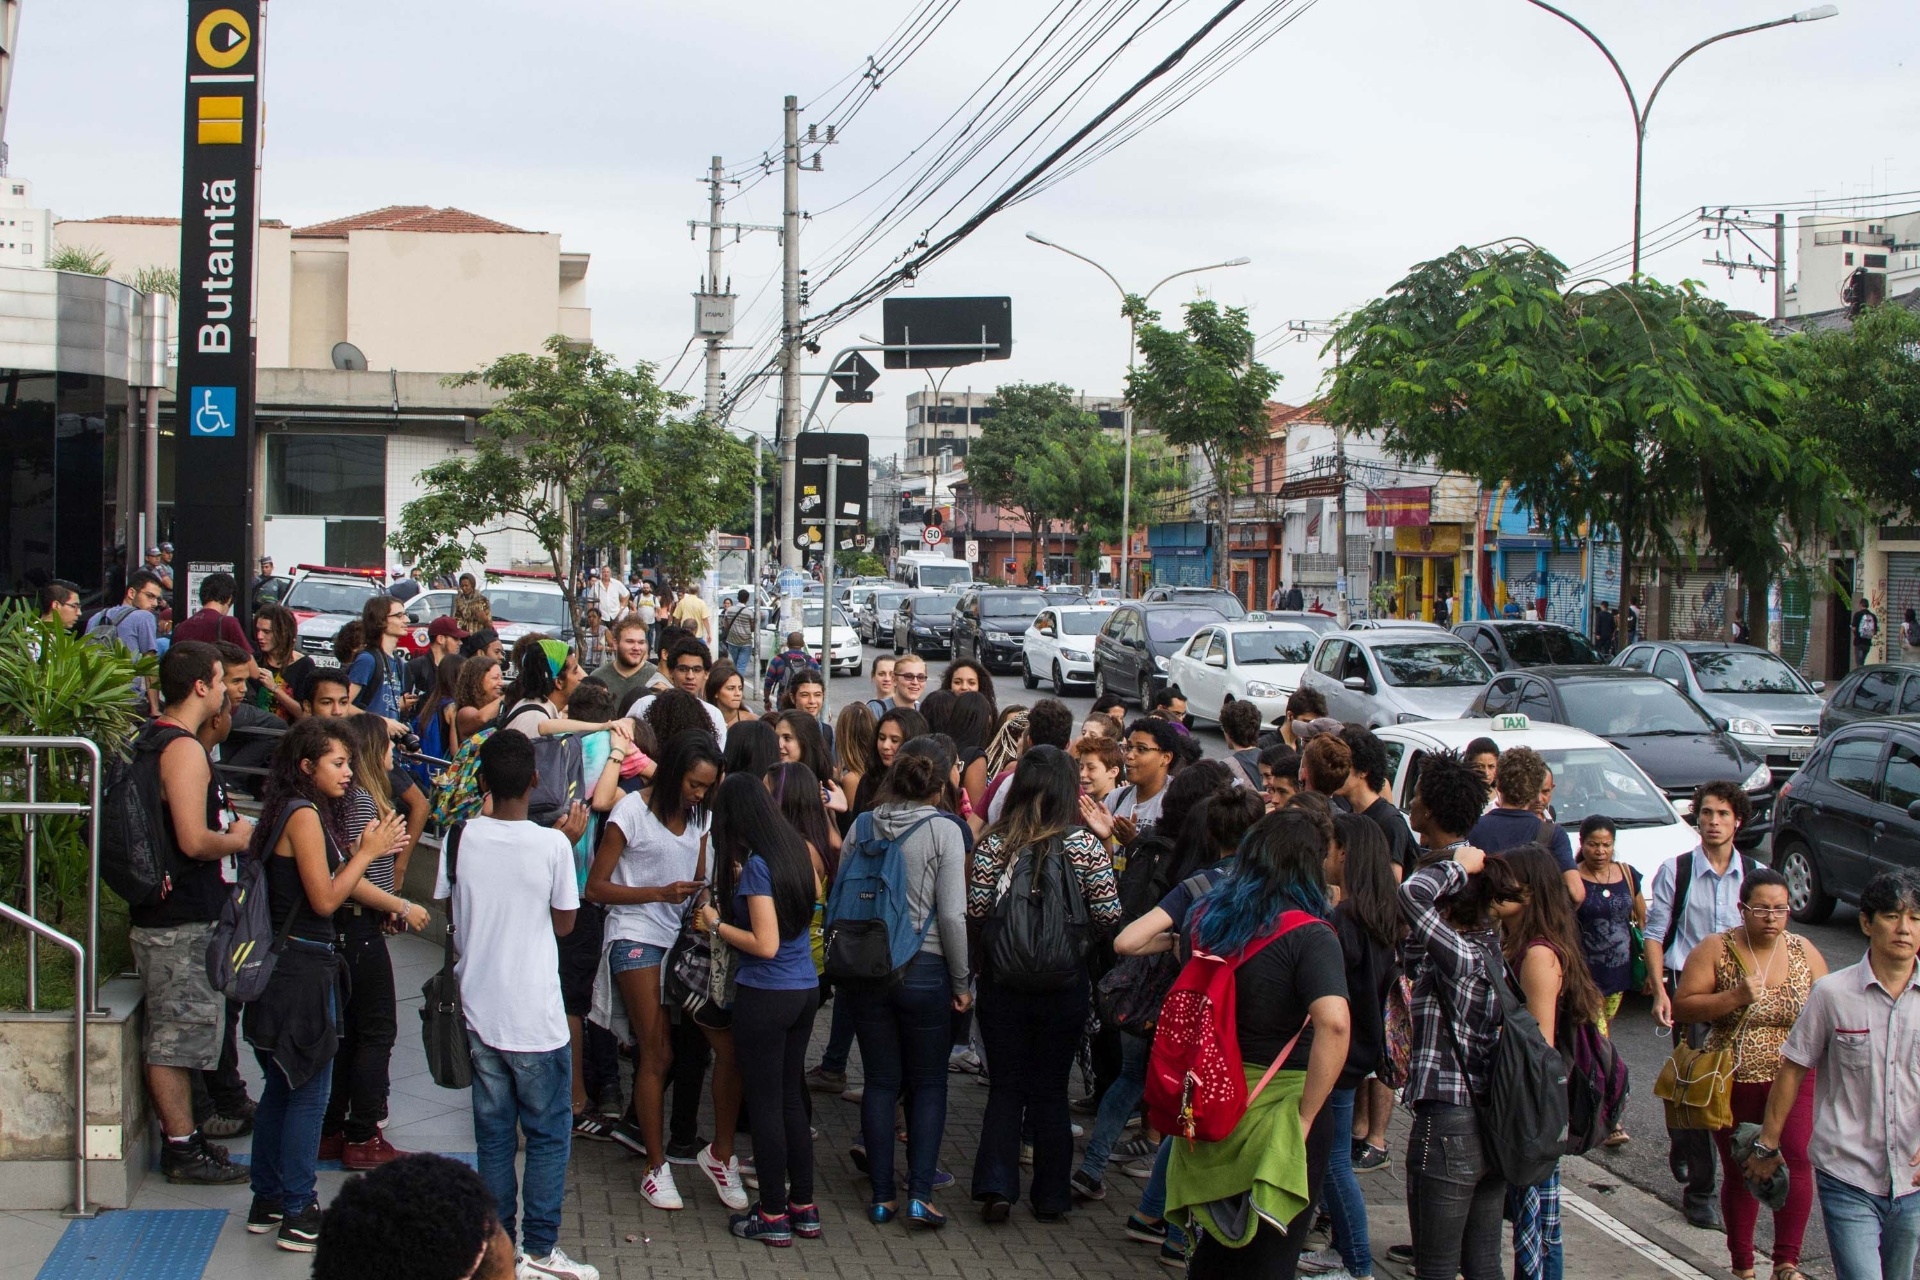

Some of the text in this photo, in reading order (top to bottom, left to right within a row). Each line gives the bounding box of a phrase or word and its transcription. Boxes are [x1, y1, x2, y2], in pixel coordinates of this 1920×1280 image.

[198, 178, 236, 353] Butantã
[927, 530, 940, 539] 50
[323, 660, 339, 668] 2448
[1501, 716, 1526, 729] TAXI
[1791, 752, 1805, 760] ELH
